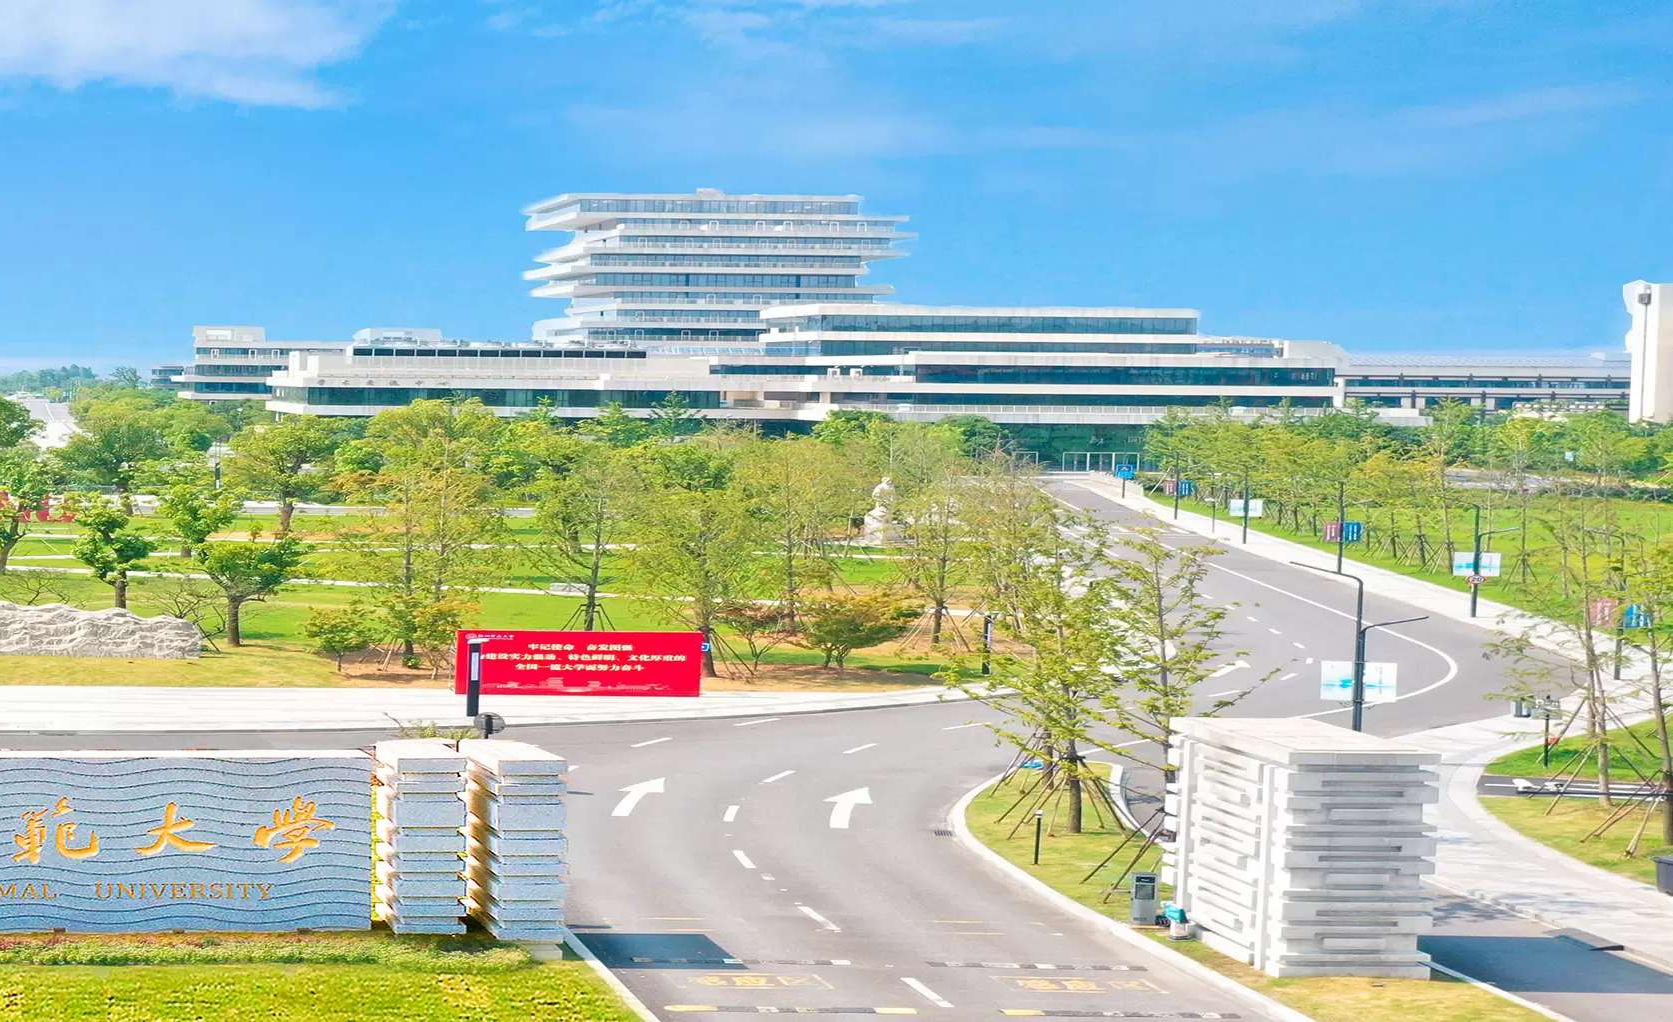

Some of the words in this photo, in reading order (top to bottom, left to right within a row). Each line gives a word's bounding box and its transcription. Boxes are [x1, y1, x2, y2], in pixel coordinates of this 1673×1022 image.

[527, 643, 575, 651] 牢记使命
[587, 643, 633, 652] 奋发图强
[480, 652, 687, 663] 建设实力强劲、特色鲜明、文化厚重的
[515, 663, 645, 672] 全国一流大学而努力奋斗
[95, 883, 274, 900] UNIVERSITY
